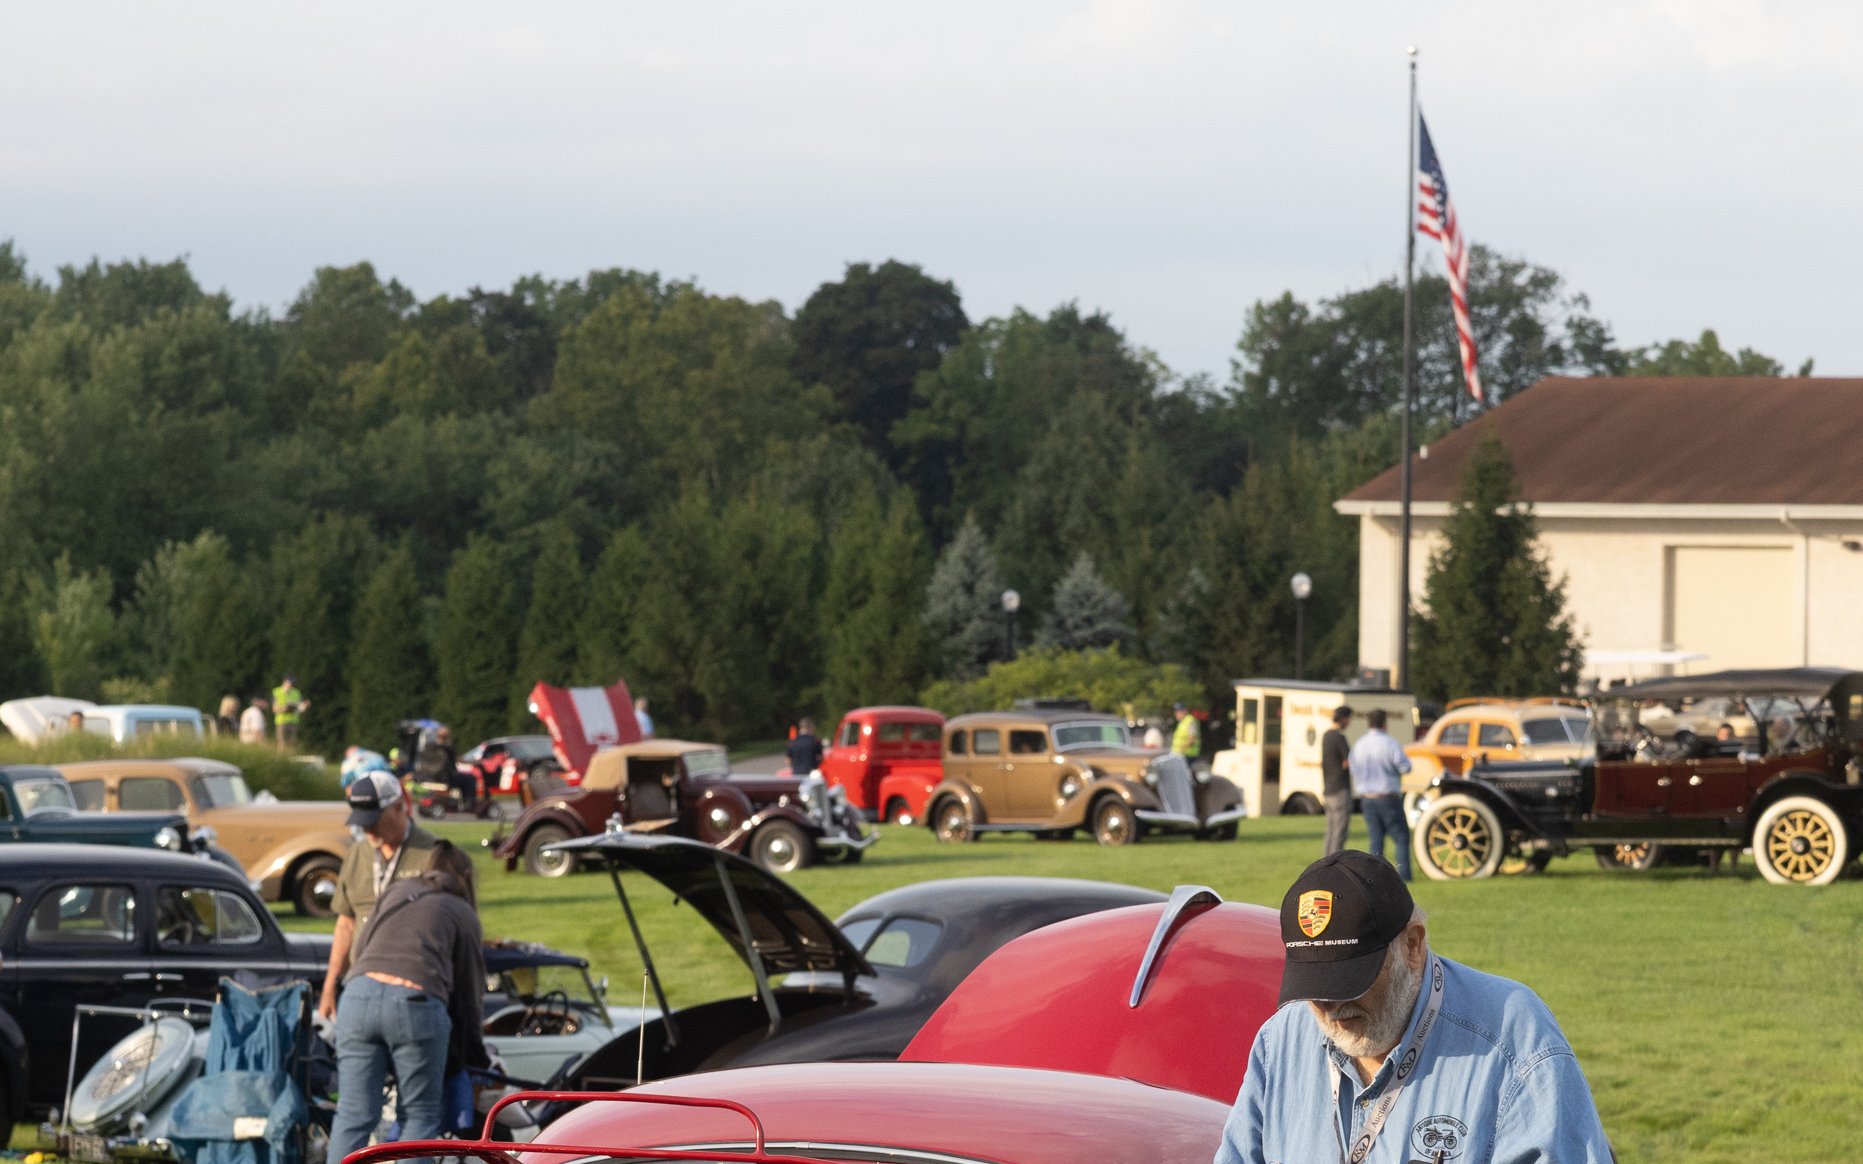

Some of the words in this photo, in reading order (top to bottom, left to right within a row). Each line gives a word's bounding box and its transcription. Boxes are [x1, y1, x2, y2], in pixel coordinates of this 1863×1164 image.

[1286, 940, 1323, 948] PORSCHE
[1325, 938, 1358, 946] MUSEUM
[1417, 1009, 1435, 1041] Auctions
[1371, 1096, 1392, 1128] Auctions
